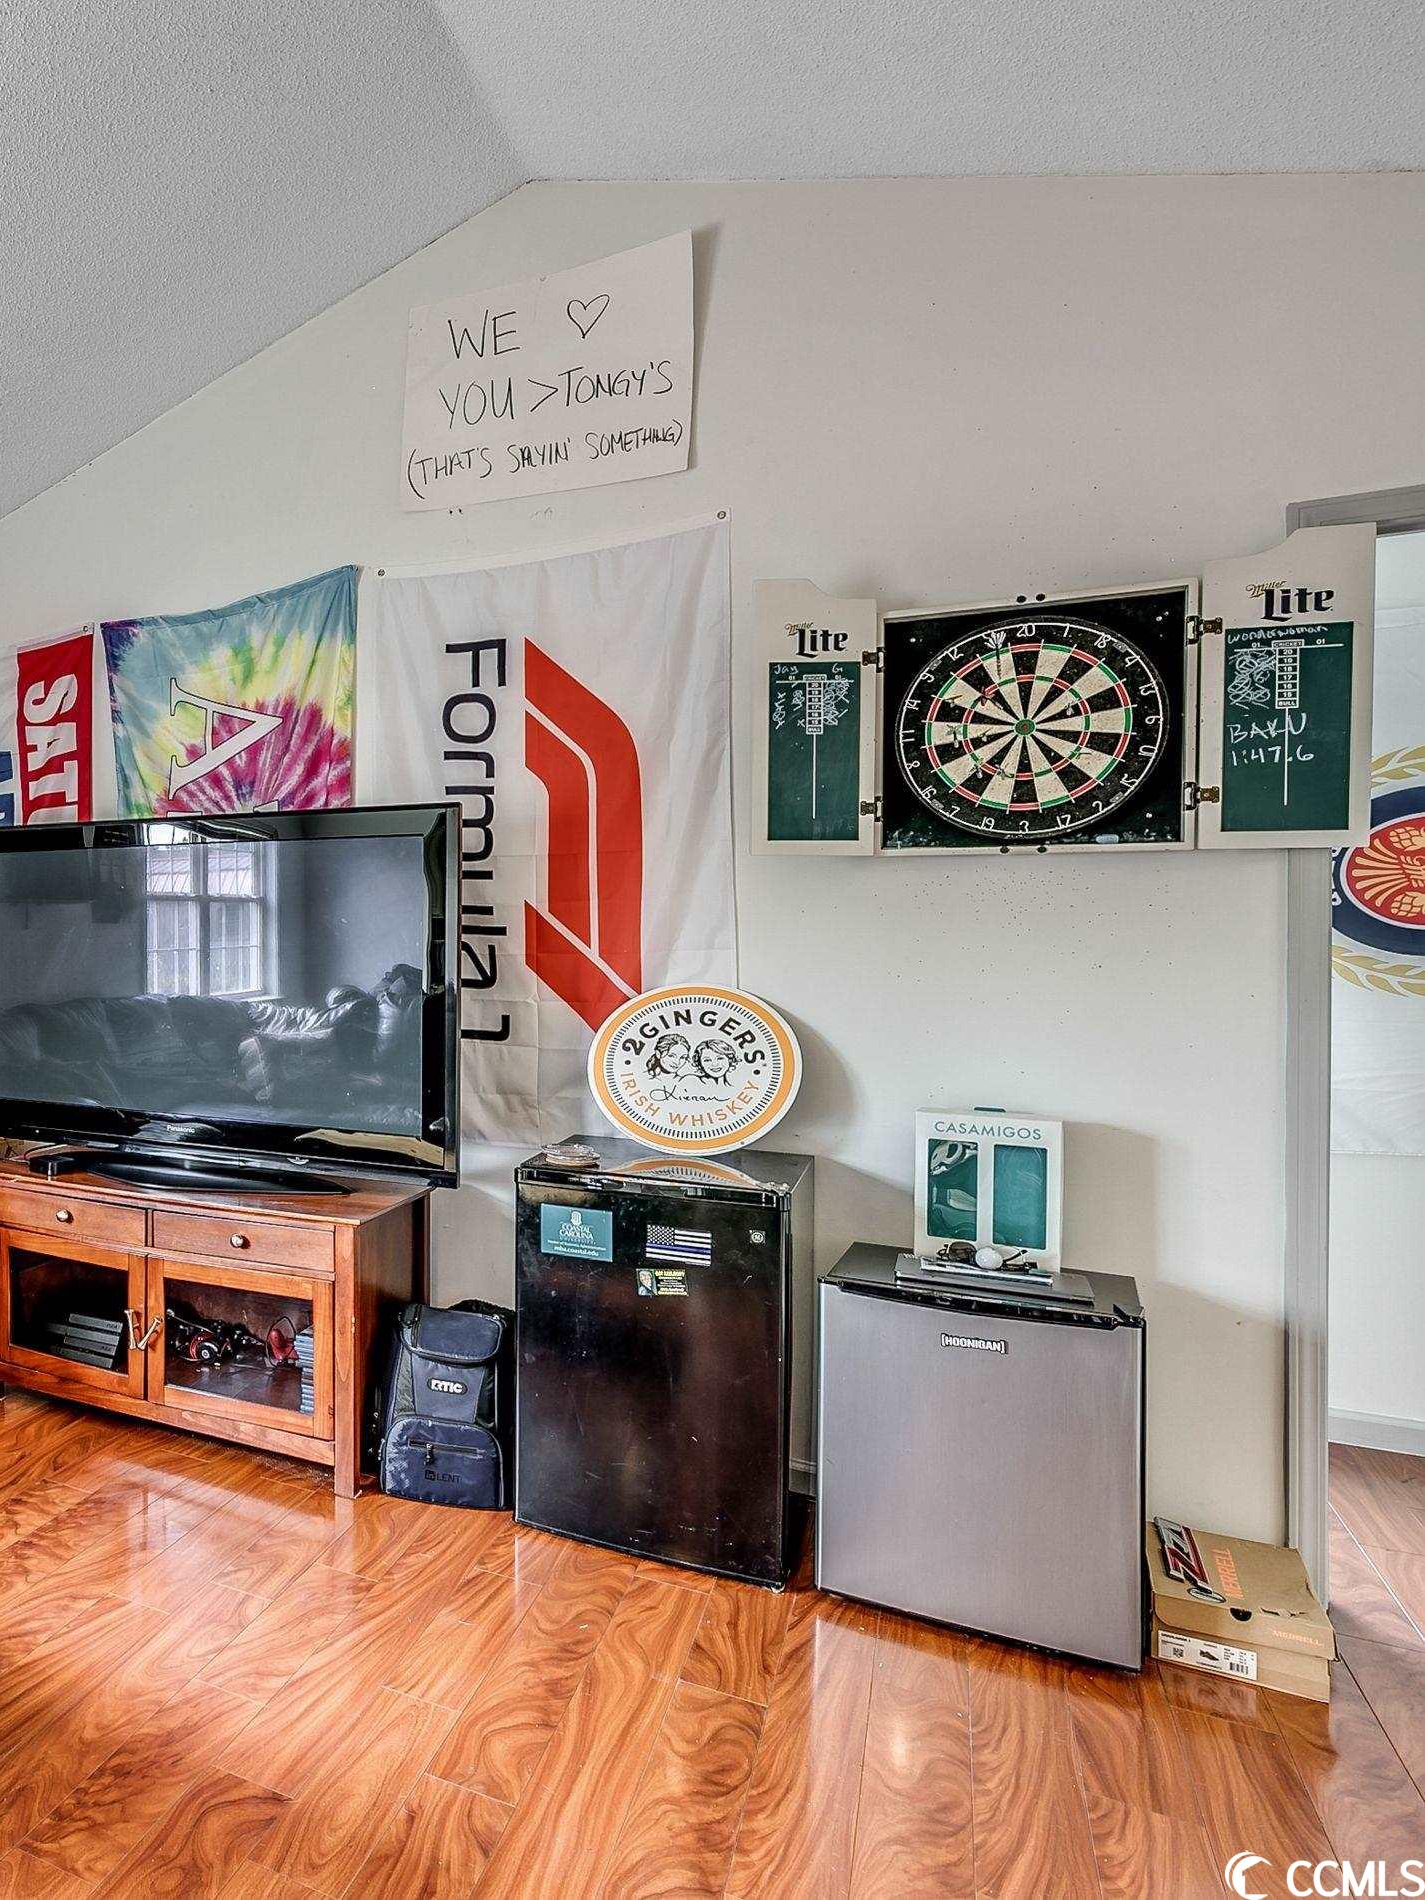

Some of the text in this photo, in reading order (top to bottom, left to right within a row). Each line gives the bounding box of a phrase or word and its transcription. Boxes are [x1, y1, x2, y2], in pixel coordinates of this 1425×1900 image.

[448, 309, 520, 359] WE
[439, 378, 514, 429] YOU
[407, 448, 492, 500] (THAT'S
[1260, 587, 1335, 622] Lite
[1016, 623, 1036, 637] 20
[1063, 623, 1071, 637] 1
[795, 629, 849, 659] Lite
[1094, 632, 1111, 648] 18
[946, 647, 964, 661] 12
[1125, 655, 1140, 667] 4
[773, 664, 799, 675] Jay
[1138, 681, 1159, 696] 13
[905, 699, 921, 710] 14
[167, 677, 285, 815] A
[1138, 744, 1157, 757] 10
[905, 760, 920, 770] 8
[1120, 773, 1139, 790] 15
[947, 805, 960, 817] 7
[1092, 799, 1103, 812] 2
[980, 816, 995, 830] 19
[1019, 820, 1029, 833] 3
[1056, 813, 1072, 828] 17
[620, 1072, 760, 1127] IRISH WHISKEY
[649, 1084, 732, 1102] Kieran
[166, 1124, 195, 1133] Panasonic
[934, 1120, 1042, 1141] CASAMIGOS
[430, 1378, 463, 1394] RTIC
